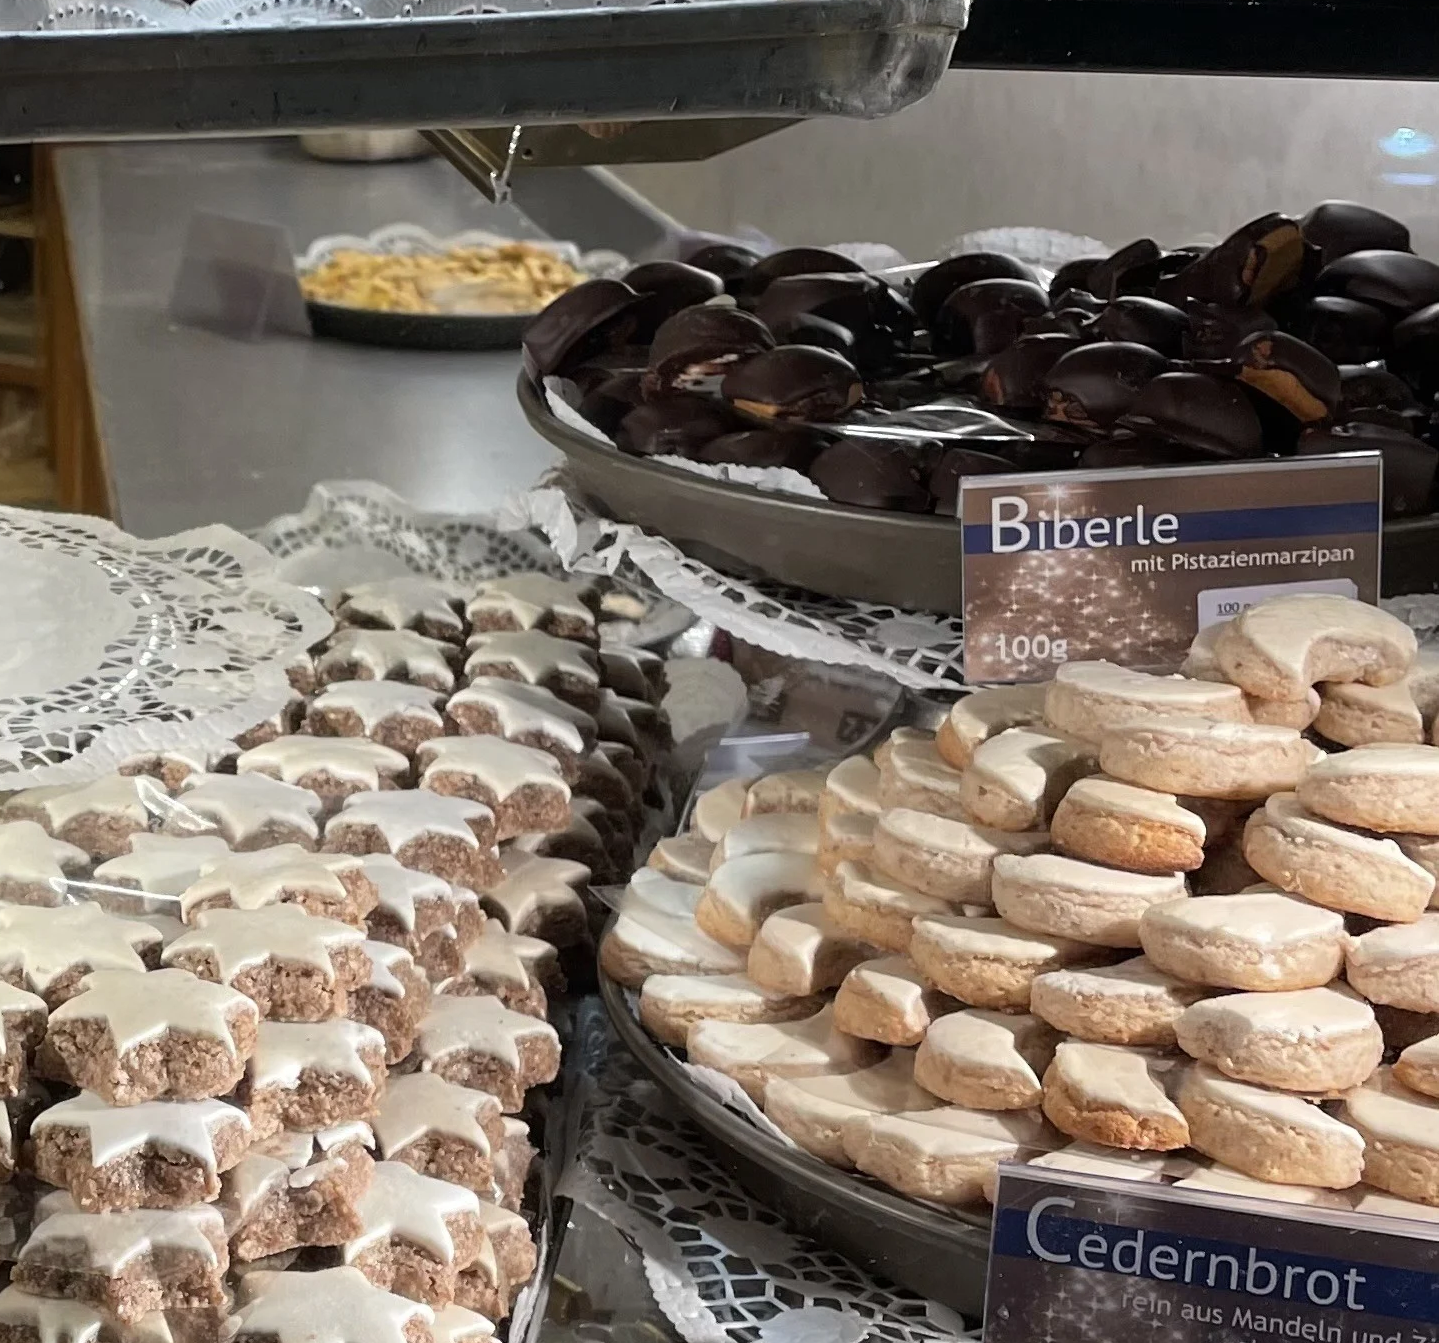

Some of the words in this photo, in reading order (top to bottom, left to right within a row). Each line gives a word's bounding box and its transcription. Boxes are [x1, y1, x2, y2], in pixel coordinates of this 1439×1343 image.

[990, 495, 1180, 554] Biberle
[1131, 558, 1166, 574] mit
[1171, 545, 1355, 572] Pistazienmarzipan
[1216, 601, 1240, 616] 100
[995, 633, 1069, 661] 100g
[1026, 1196, 1367, 1311] Cedernbrot
[1121, 1291, 1172, 1317] rein
[1180, 1301, 1223, 1325] aus
[1231, 1305, 1342, 1343] Mandeln
